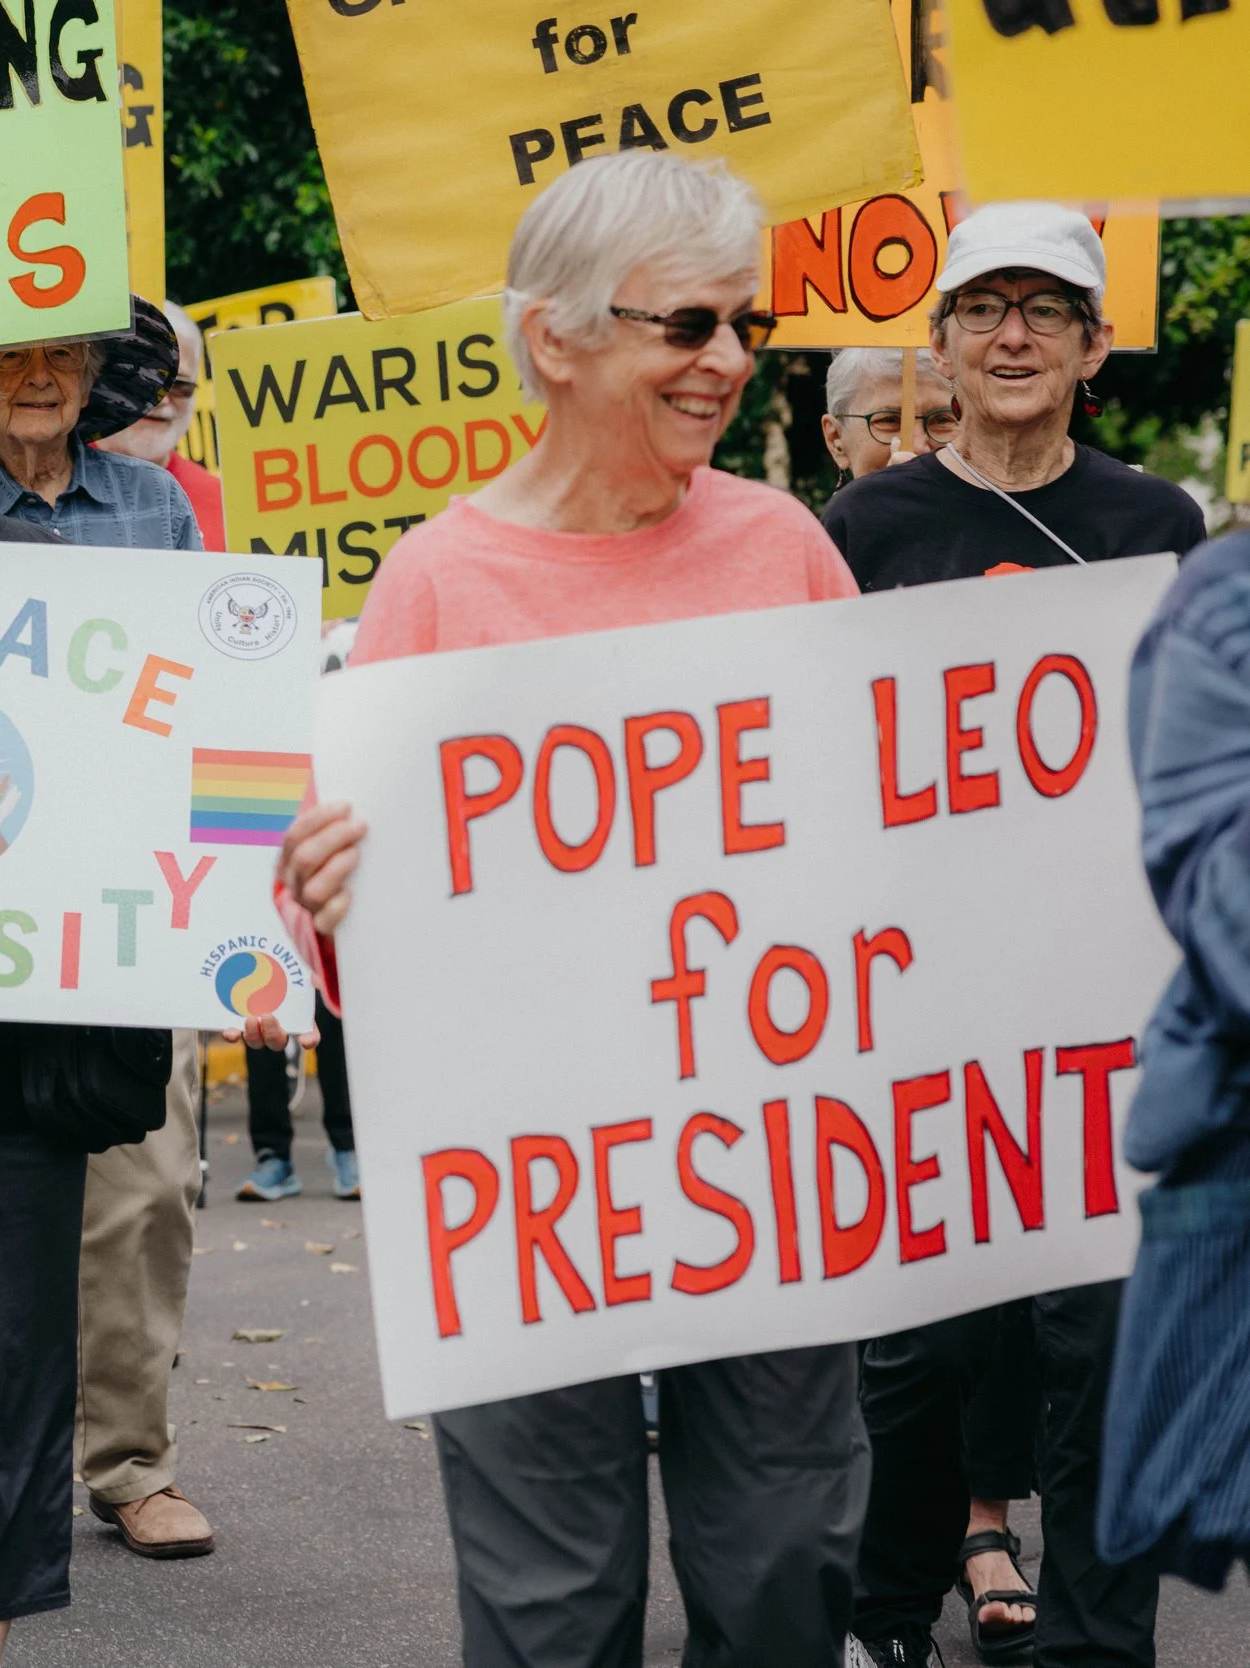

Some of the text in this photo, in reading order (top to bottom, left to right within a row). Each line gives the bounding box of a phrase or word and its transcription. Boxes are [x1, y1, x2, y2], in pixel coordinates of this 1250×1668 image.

[532, 11, 639, 74] for
[508, 72, 772, 186] PEACE
[227, 333, 500, 428] WAR IS
[215, 611, 280, 647] Unity Culture History
[439, 652, 1098, 897] POPE LEO
[199, 935, 305, 987] HISPANIC UNITY
[651, 890, 914, 1081] for
[421, 1036, 1137, 1339] PRESIDENT
